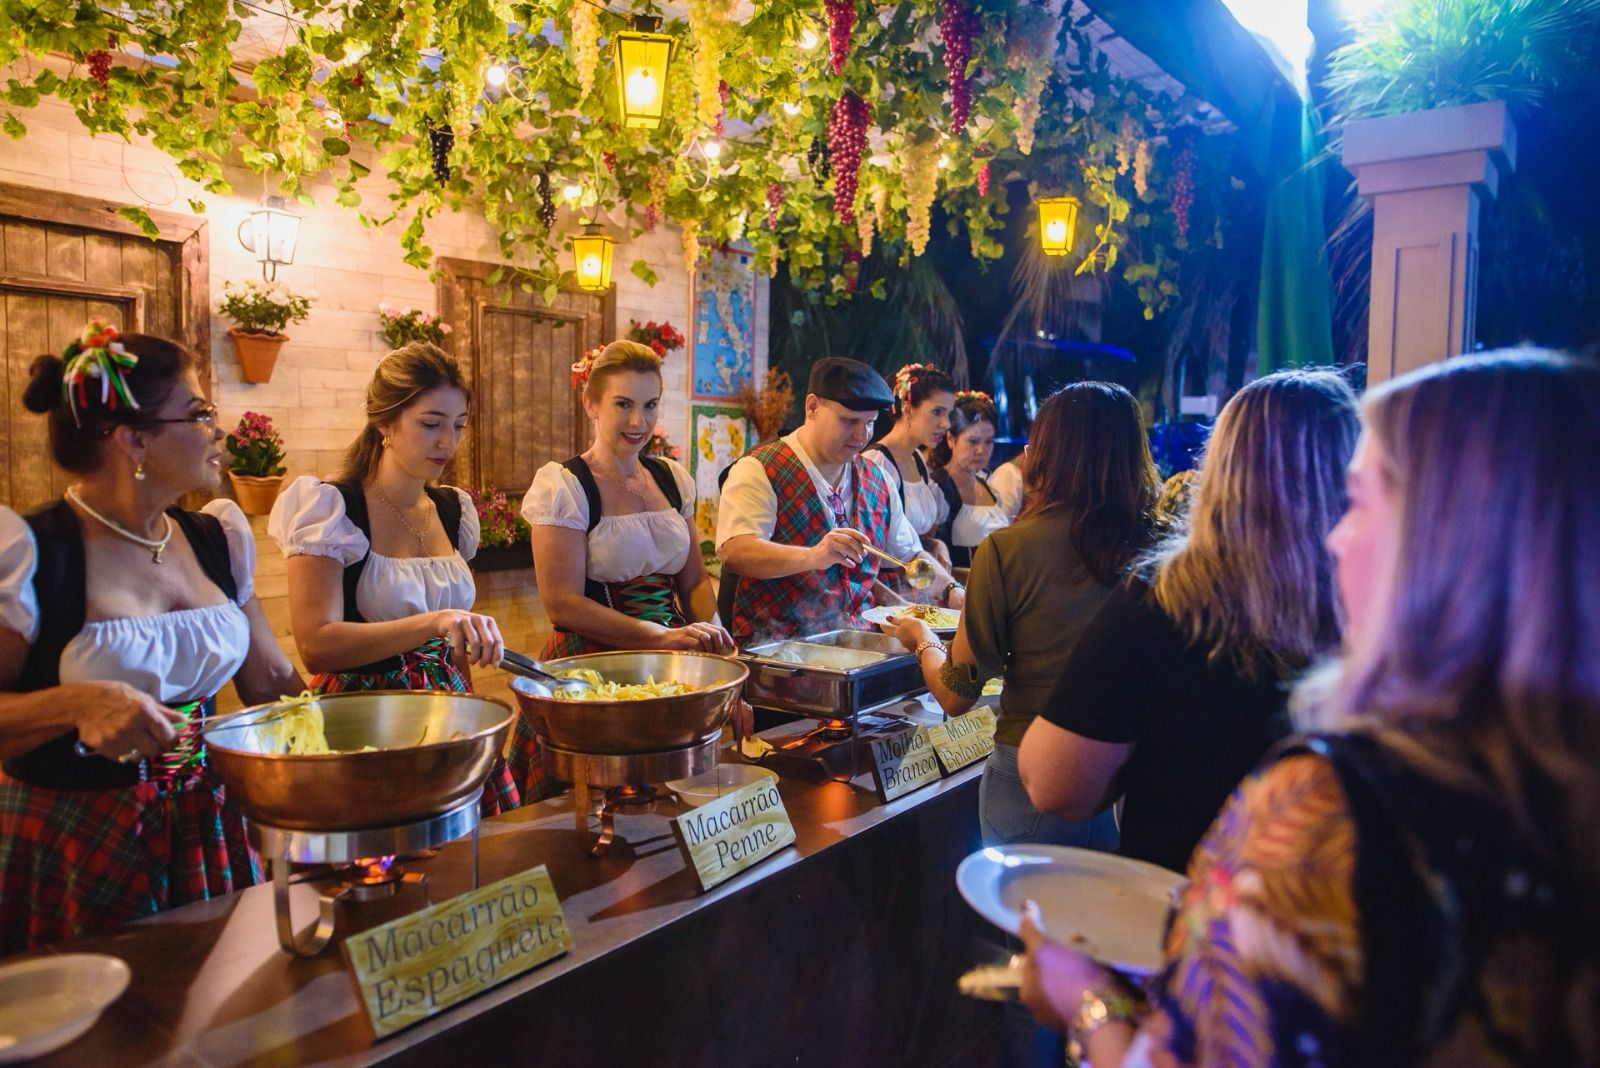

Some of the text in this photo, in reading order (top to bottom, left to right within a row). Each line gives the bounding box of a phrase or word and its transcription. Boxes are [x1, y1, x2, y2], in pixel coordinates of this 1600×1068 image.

[878, 732, 924, 764] Molho
[944, 715, 985, 742] Molho
[884, 756, 937, 790] Branco
[685, 787, 779, 846] Macarrão
[715, 823, 777, 869] Penne
[364, 884, 539, 973] Macarrão
[375, 915, 566, 1018] Espaguete
